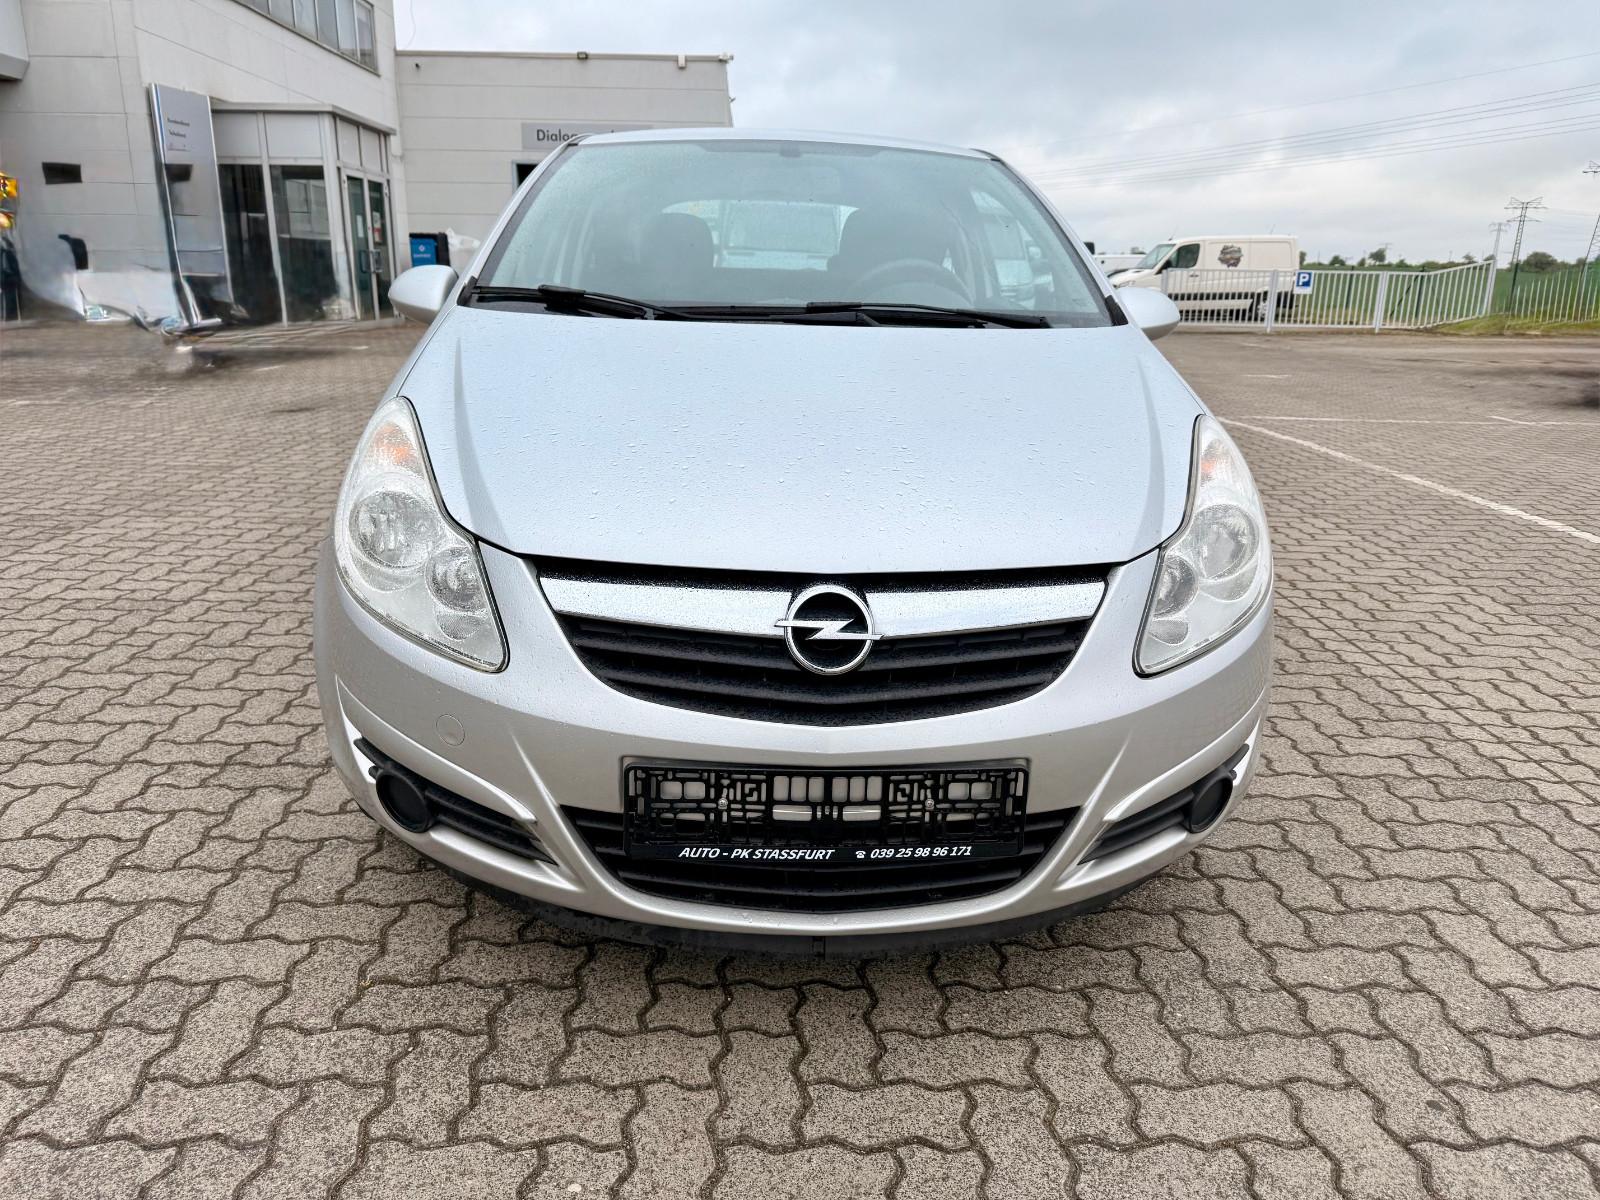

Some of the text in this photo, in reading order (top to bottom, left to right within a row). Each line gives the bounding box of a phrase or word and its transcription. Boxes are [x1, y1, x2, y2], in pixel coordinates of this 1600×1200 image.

[1299, 273, 1309, 286] P
[678, 847, 721, 859] AUTO
[730, 848, 753, 859] PK
[752, 848, 836, 860] STASSFURT
[870, 848, 895, 859] 039
[896, 848, 914, 858] 25
[914, 847, 932, 858] 98
[932, 846, 950, 857] 96
[950, 845, 972, 856] 171
